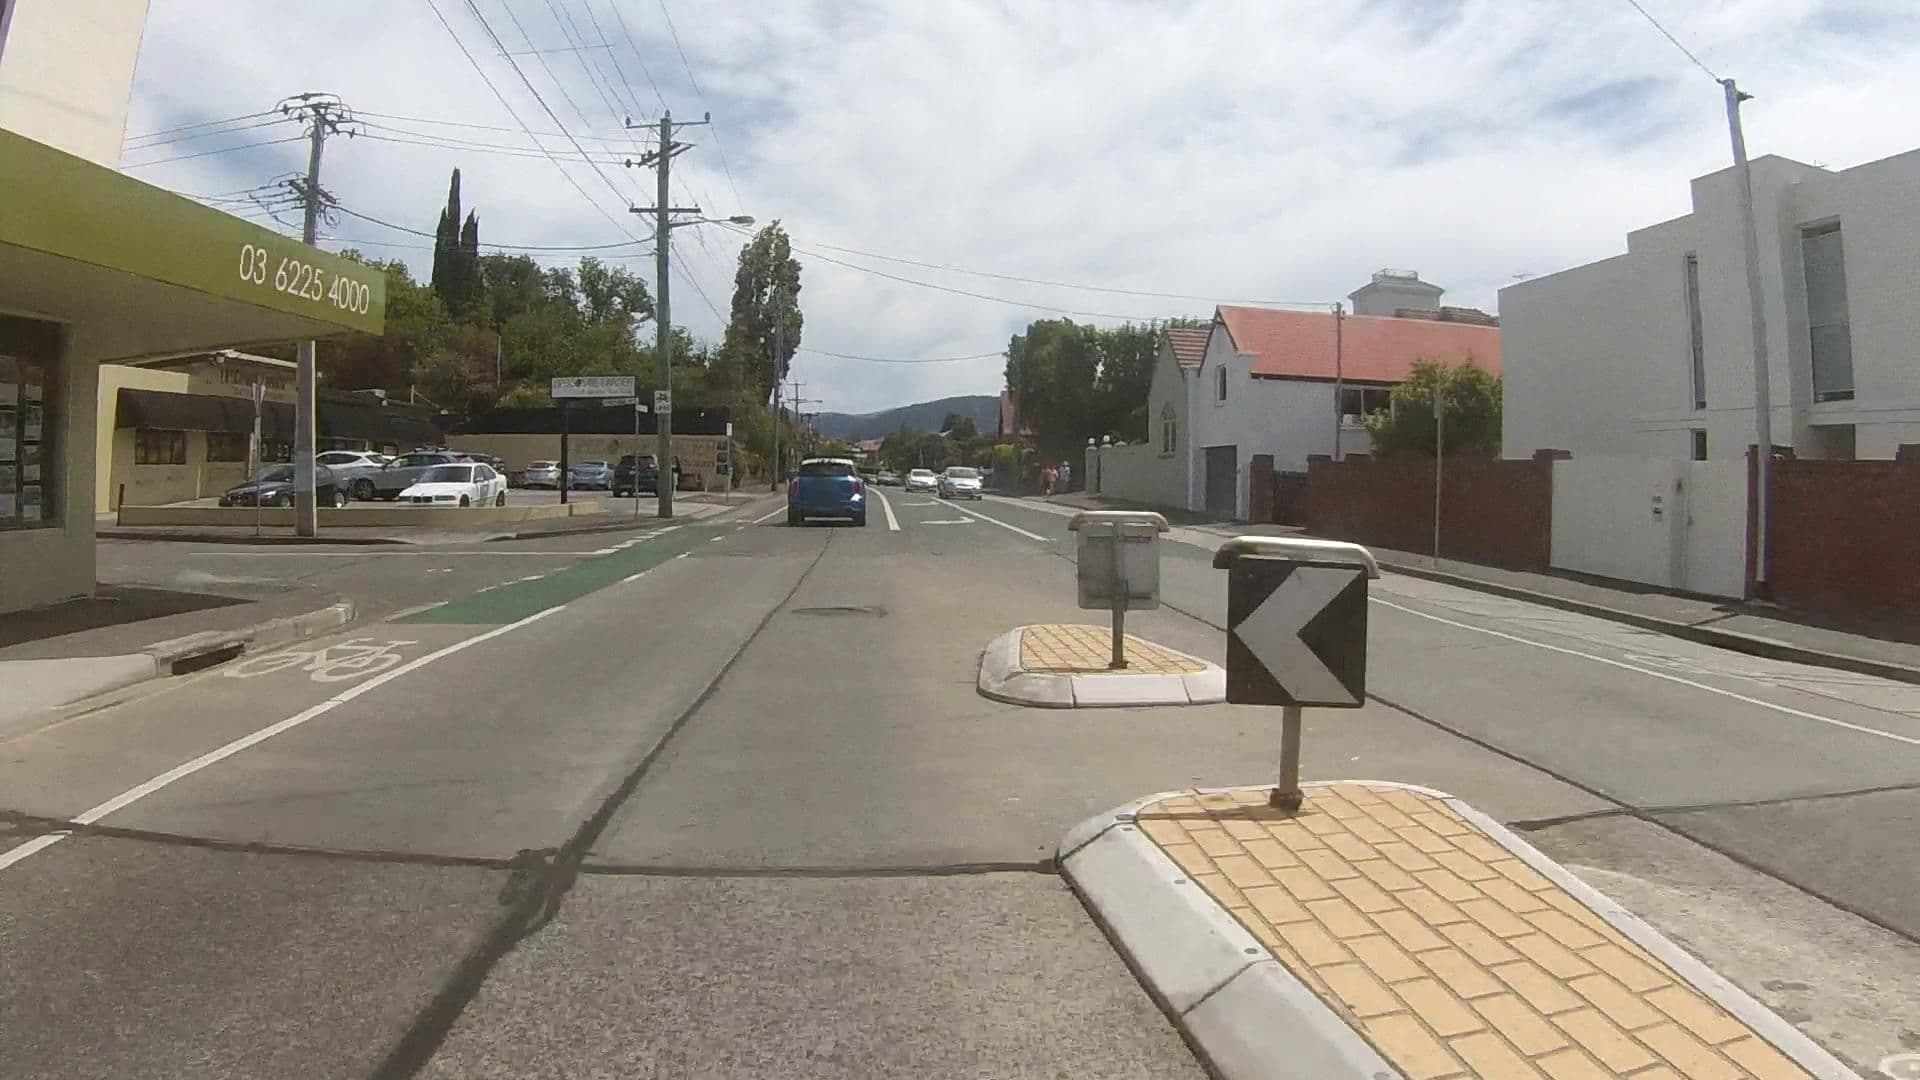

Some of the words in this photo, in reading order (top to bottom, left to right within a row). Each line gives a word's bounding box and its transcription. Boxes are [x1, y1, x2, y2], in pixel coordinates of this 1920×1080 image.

[239, 244, 267, 285] 03
[275, 257, 325, 302] 6225
[328, 274, 370, 314] 4000
